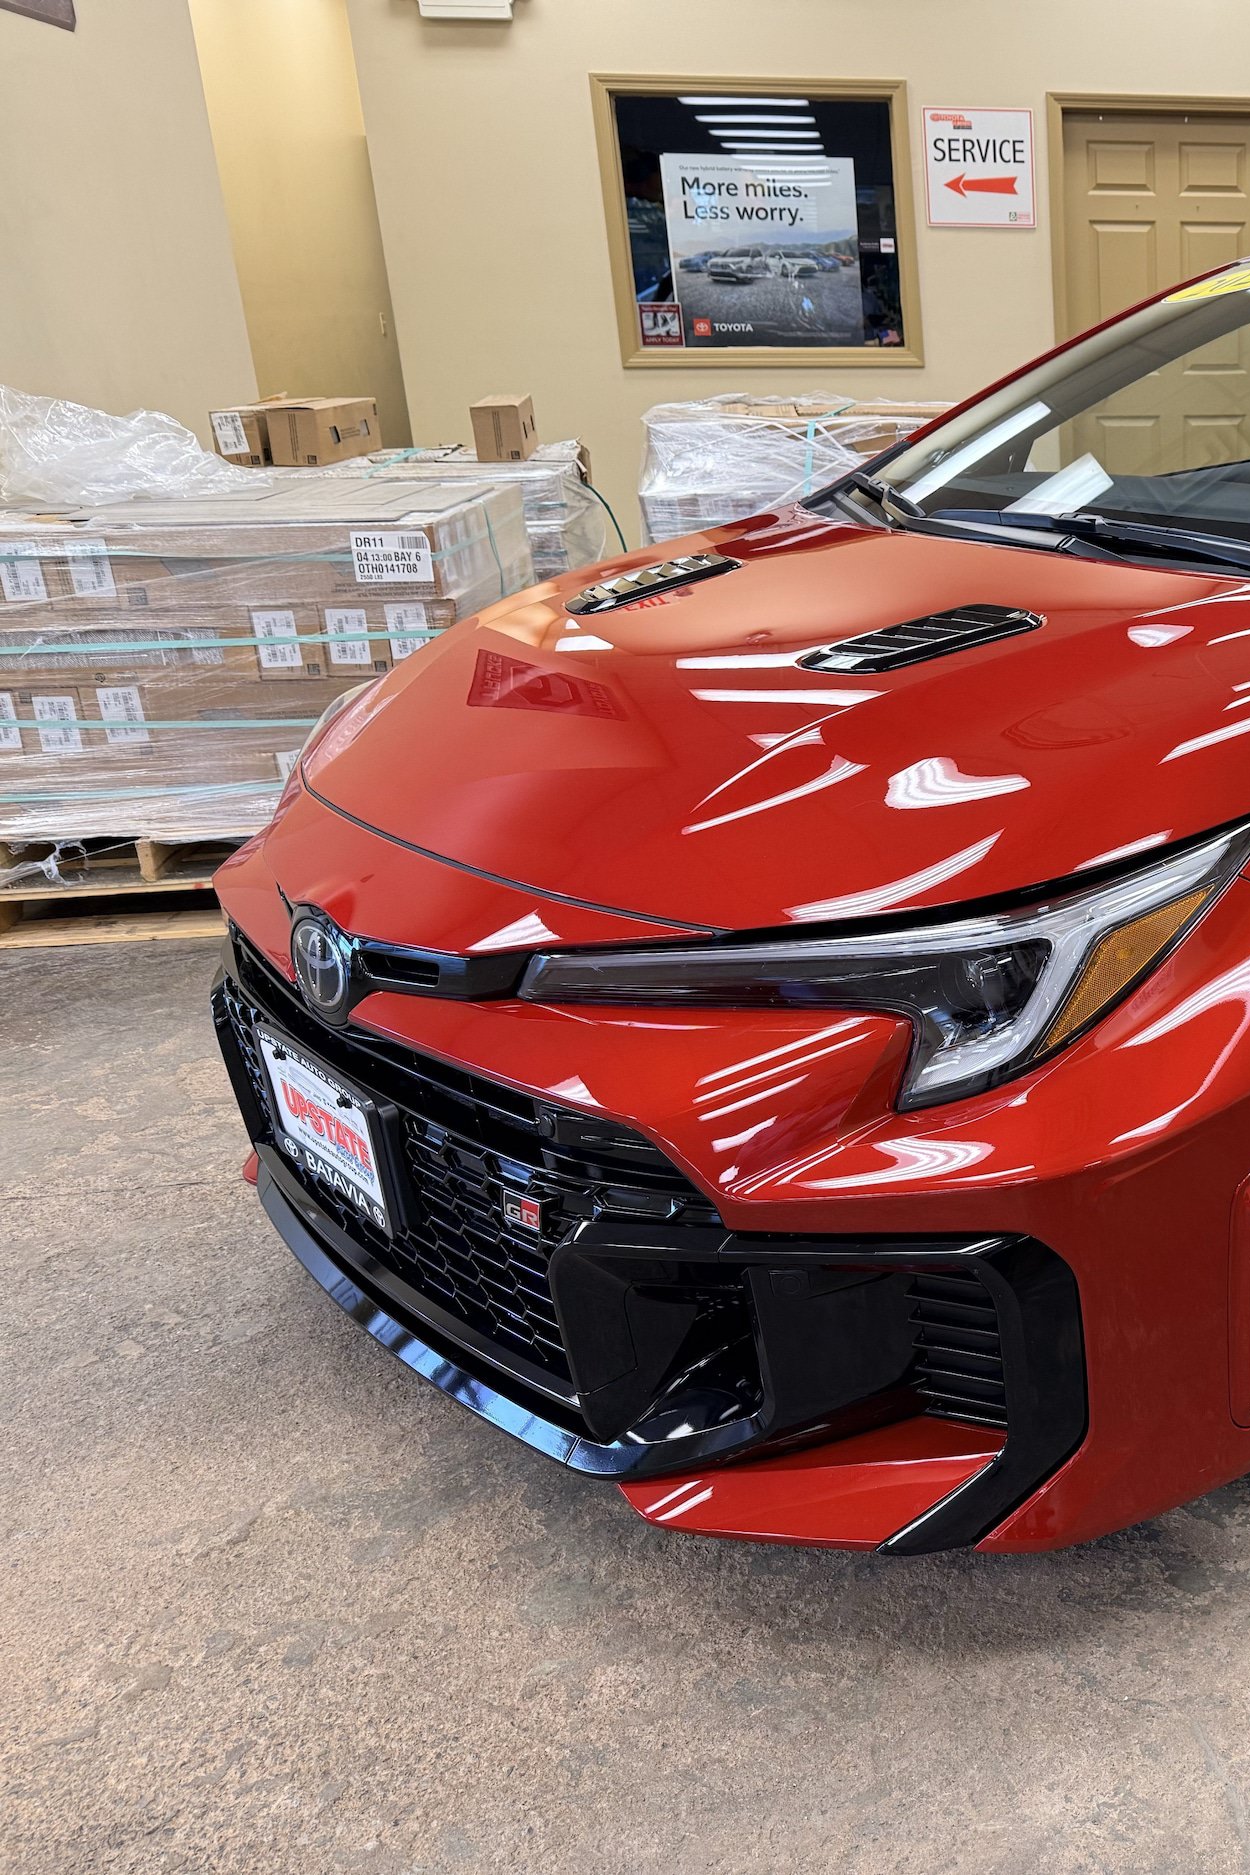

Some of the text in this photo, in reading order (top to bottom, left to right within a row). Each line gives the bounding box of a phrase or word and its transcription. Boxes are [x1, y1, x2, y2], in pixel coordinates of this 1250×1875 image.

[933, 138, 1025, 164] SERVICE
[681, 177, 808, 198] More miles.
[683, 200, 804, 226] Less worry.
[713, 323, 754, 332] TOYOTA
[355, 537, 384, 548] DR11
[356, 552, 422, 562] 04 13:00 BAY 6
[256, 1028, 300, 1061] UPSTATE
[299, 1058, 327, 1081] AUTO
[328, 1078, 361, 1108] GROUP
[280, 1077, 374, 1172] UPSTATE
[305, 1150, 371, 1216] BATAVIA
[506, 1203, 538, 1227] GR
